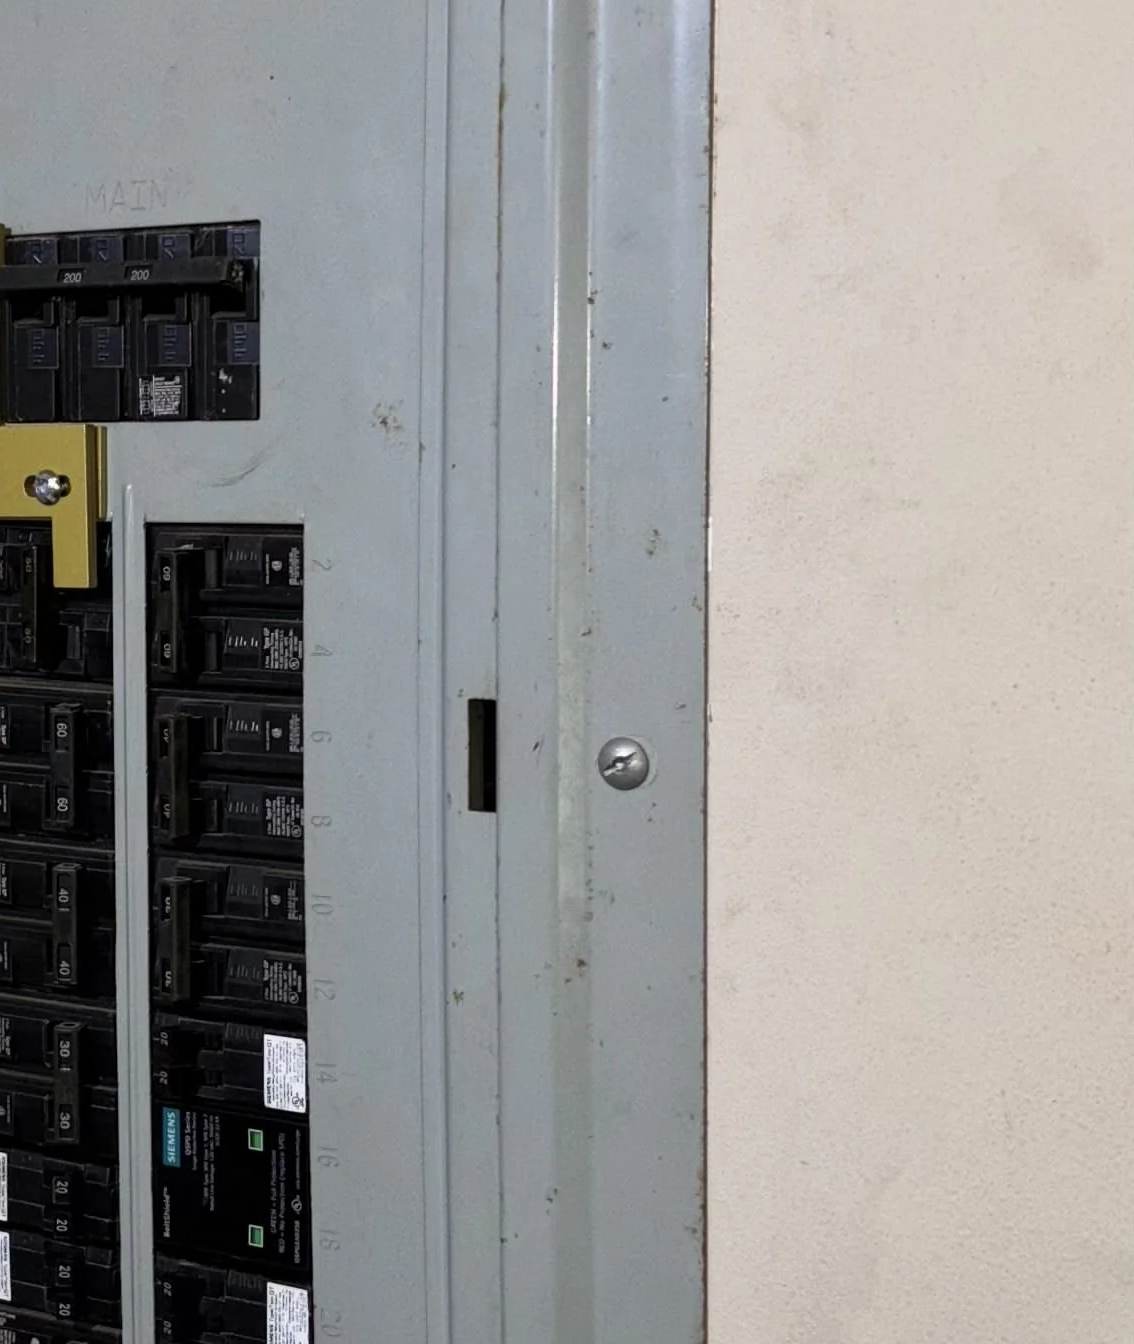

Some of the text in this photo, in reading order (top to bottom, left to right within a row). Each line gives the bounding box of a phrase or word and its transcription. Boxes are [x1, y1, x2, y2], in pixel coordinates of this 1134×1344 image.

[84, 179, 168, 212] MAIN
[63, 269, 150, 284] 200 200
[162, 566, 171, 581] 60
[162, 643, 171, 658] 60
[56, 723, 69, 738] 60
[57, 797, 69, 812] 60
[58, 888, 71, 903] 40
[60, 960, 72, 976] 40
[60, 1041, 72, 1057] 30
[60, 1112, 72, 1129] 30
[167, 1111, 176, 1163] SIEMENS
[56, 1180, 69, 1195] 20
[56, 1219, 69, 1233] 20
[58, 1265, 72, 1280] 20
[59, 1303, 72, 1317] 20
